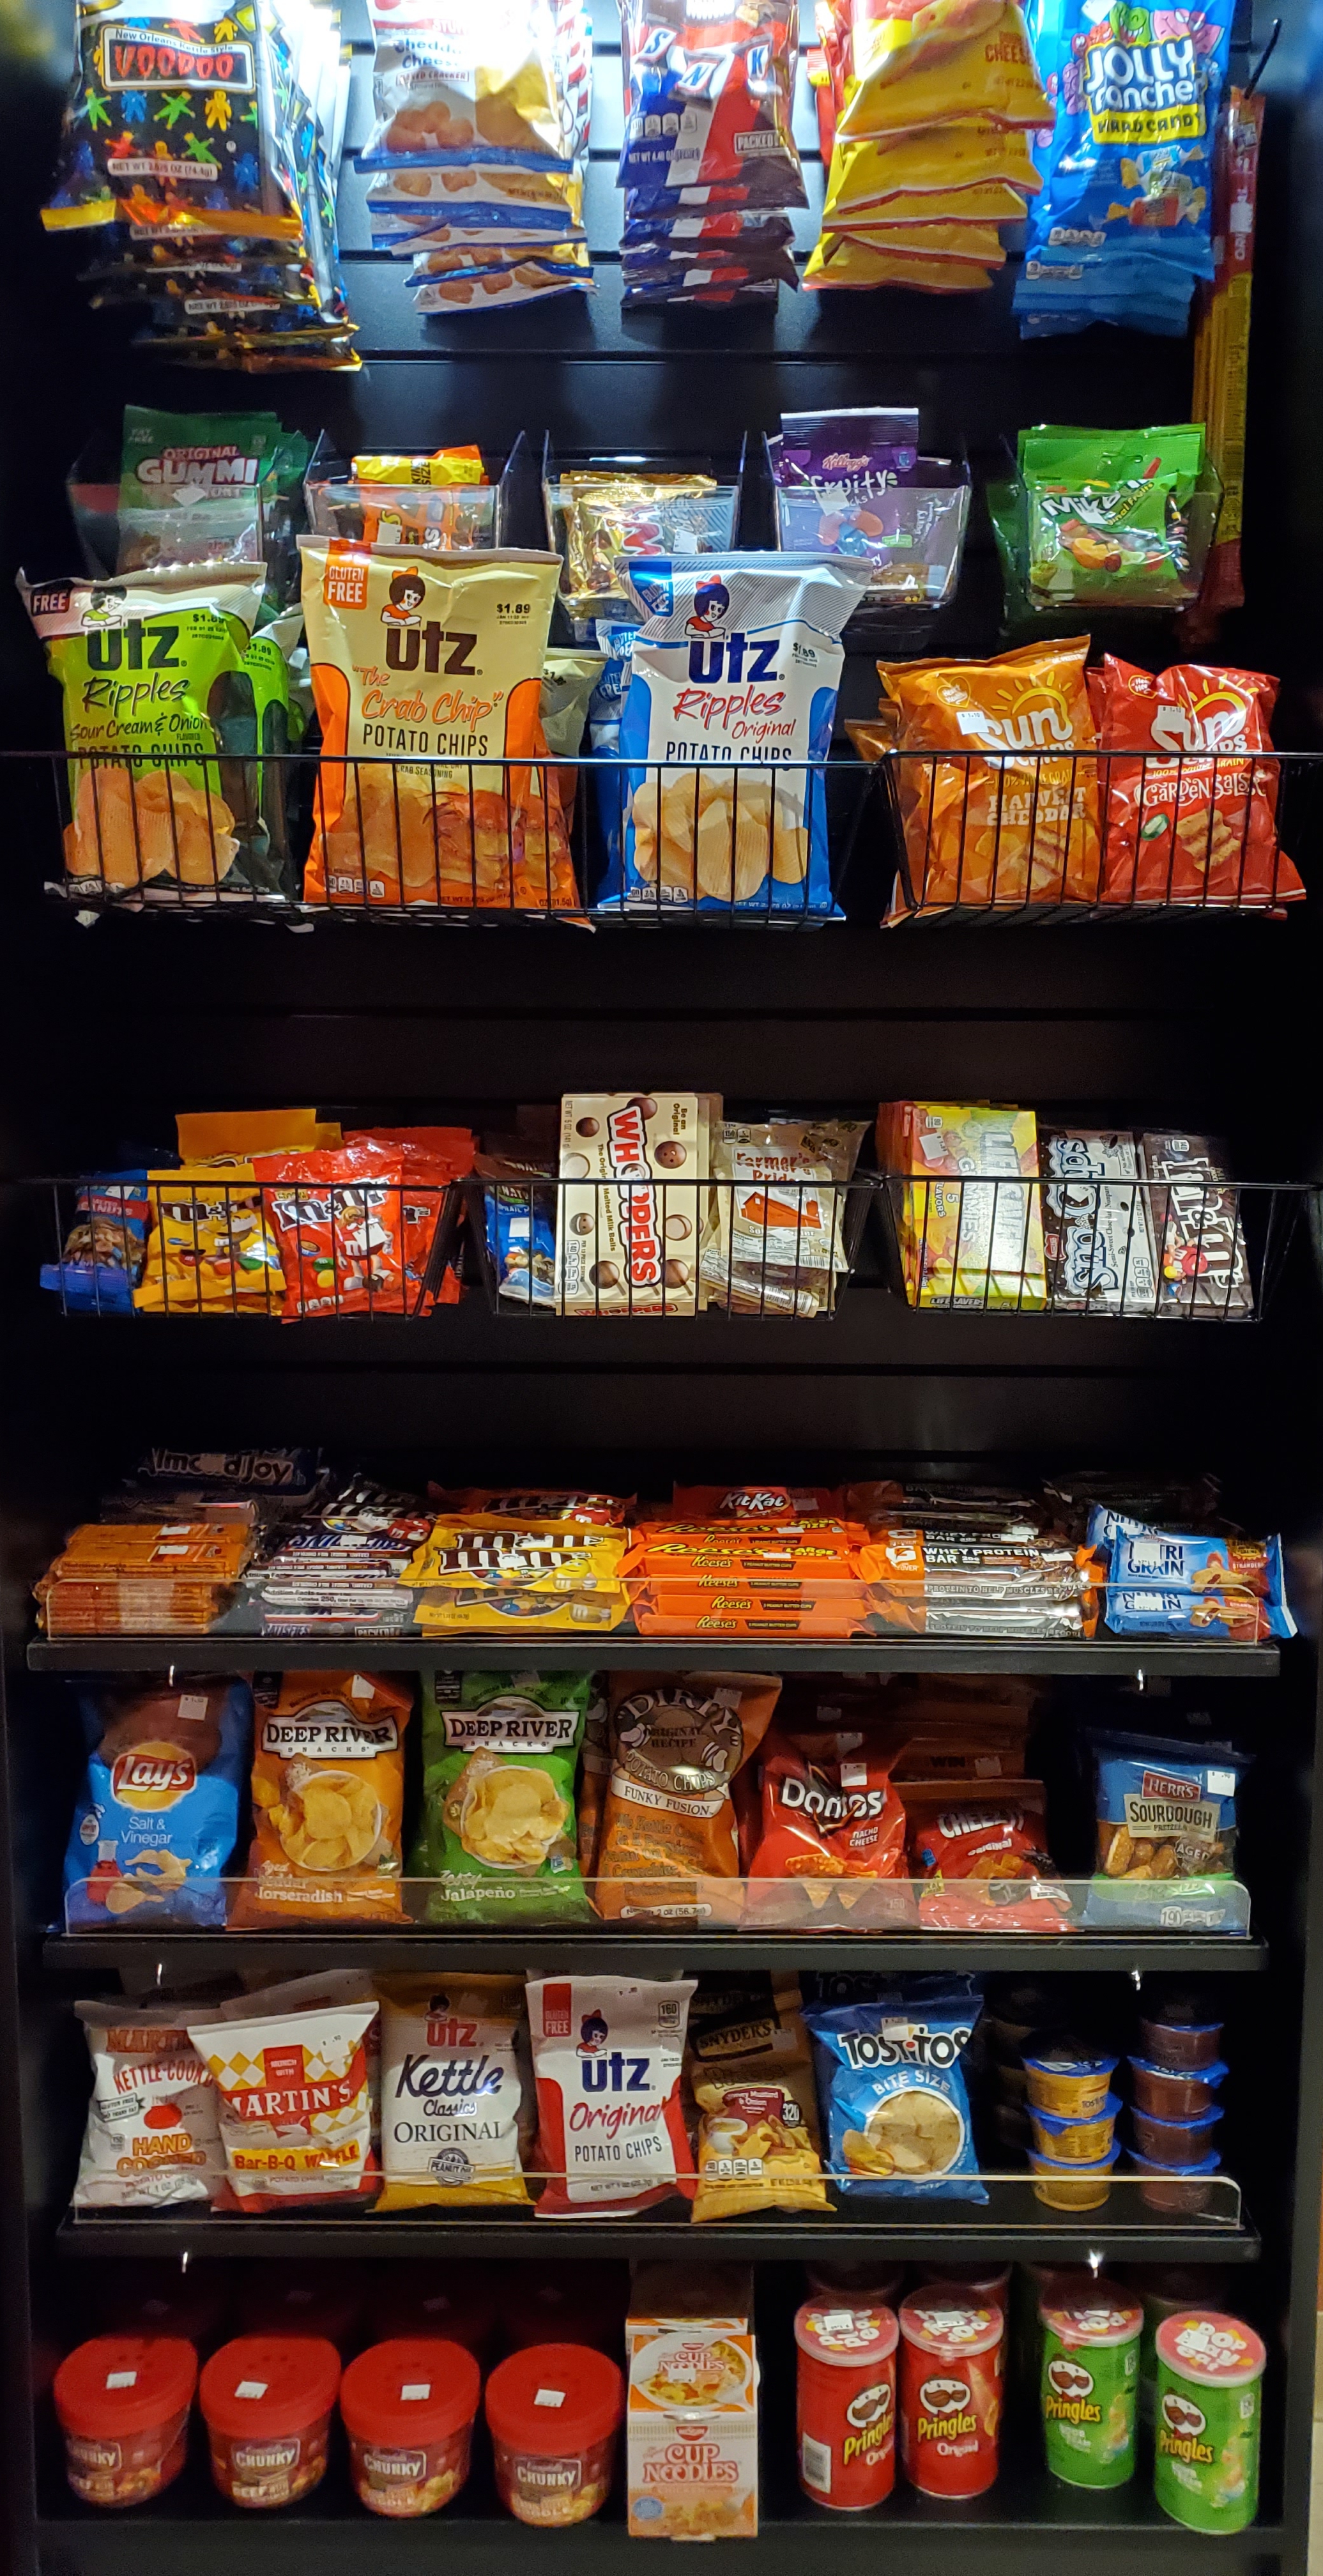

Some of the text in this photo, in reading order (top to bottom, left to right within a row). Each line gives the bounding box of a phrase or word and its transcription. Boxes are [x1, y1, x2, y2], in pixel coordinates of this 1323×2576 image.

[116, 29, 233, 54] New Orleans Kettle Style
[114, 45, 234, 79] VOODOO
[1087, 39, 1193, 91] JOLLY
[164, 447, 240, 459] ORIGINAL
[137, 458, 258, 484] GUMMI
[329, 565, 364, 581] GLUTEN
[327, 581, 363, 604] FREE
[33, 594, 66, 613] FREE
[496, 603, 530, 614] $1.89
[82, 672, 190, 718] Ripples
[362, 689, 427, 723] Crab
[673, 684, 786, 730] Ripples
[70, 723, 105, 743] Sour
[107, 718, 153, 738] Cream
[169, 714, 208, 732] Onion
[731, 718, 797, 744] Original
[977, 707, 1074, 770] Sun
[1147, 709, 1246, 768] Sun
[362, 723, 488, 757] POTATO CHIPS
[1217, 758, 1244, 769] GRAIN
[680, 1108, 687, 1130] Be an
[1057, 1138, 1105, 1217] Cps
[602, 1188, 611, 1214] Malted
[614, 1110, 657, 1282] WHPERS
[946, 1193, 959, 1203] 5
[959, 1157, 980, 1242] GMMIES
[1108, 1236, 1118, 1268] Semi-Sweet
[704, 1533, 742, 1544] Reese's
[646, 1544, 836, 1555] Reese's LARGE
[924, 1547, 1039, 1557] WHEY PROTEIN
[926, 1555, 958, 1564] BAR
[692, 1556, 733, 1568] Reese's
[1128, 1560, 1185, 1577] GRAIN
[698, 1574, 738, 1587] Reese's
[928, 1585, 965, 1593] PROTEIN
[1006, 1586, 1046, 1594] MUSCLES
[712, 1595, 753, 1609] Reese's
[696, 1616, 737, 1629] Reese's
[266, 1724, 393, 1744] DEEP RIVER
[450, 1719, 573, 1738] DEEP RIVER
[625, 1749, 669, 1788] POTATO
[781, 1777, 883, 1818] Doritos
[1149, 1778, 1195, 1799] HERR'S
[624, 1785, 711, 1816] FUNKY FUSION
[129, 1816, 166, 1830] Salt &
[1129, 1801, 1213, 1829] SOURDOUGH
[121, 1831, 173, 1846] Vinegar
[849, 1834, 878, 1846] CHEESE
[852, 1827, 878, 1839] NACHO
[1176, 1845, 1211, 1860] AGED
[661, 2002, 677, 2015] 160
[546, 2021, 569, 2035] FREE
[395, 2054, 505, 2099] Kettle
[872, 2069, 952, 2096] BITE SIZE
[230, 2080, 351, 2117] MARTIN'S
[424, 2099, 477, 2117] Classics
[569, 2096, 666, 2140] Original
[783, 2103, 799, 2121] 320
[133, 2133, 192, 2156] HAND
[575, 2135, 662, 2163] POTATO CHIPS
[234, 2154, 296, 2170] Bar-B-Q
[675, 2351, 712, 2362] CUP
[1046, 2395, 1101, 2424] Pringles
[917, 2414, 977, 2443] Pringles
[665, 2444, 720, 2464] CUP
[1159, 2430, 1214, 2463] Pringles
[235, 2450, 296, 2468] CHUNKY
[365, 2458, 422, 2477] CHUNKY
[517, 2467, 576, 2487] CHUNKY
[643, 2462, 739, 2483] NOODLES
